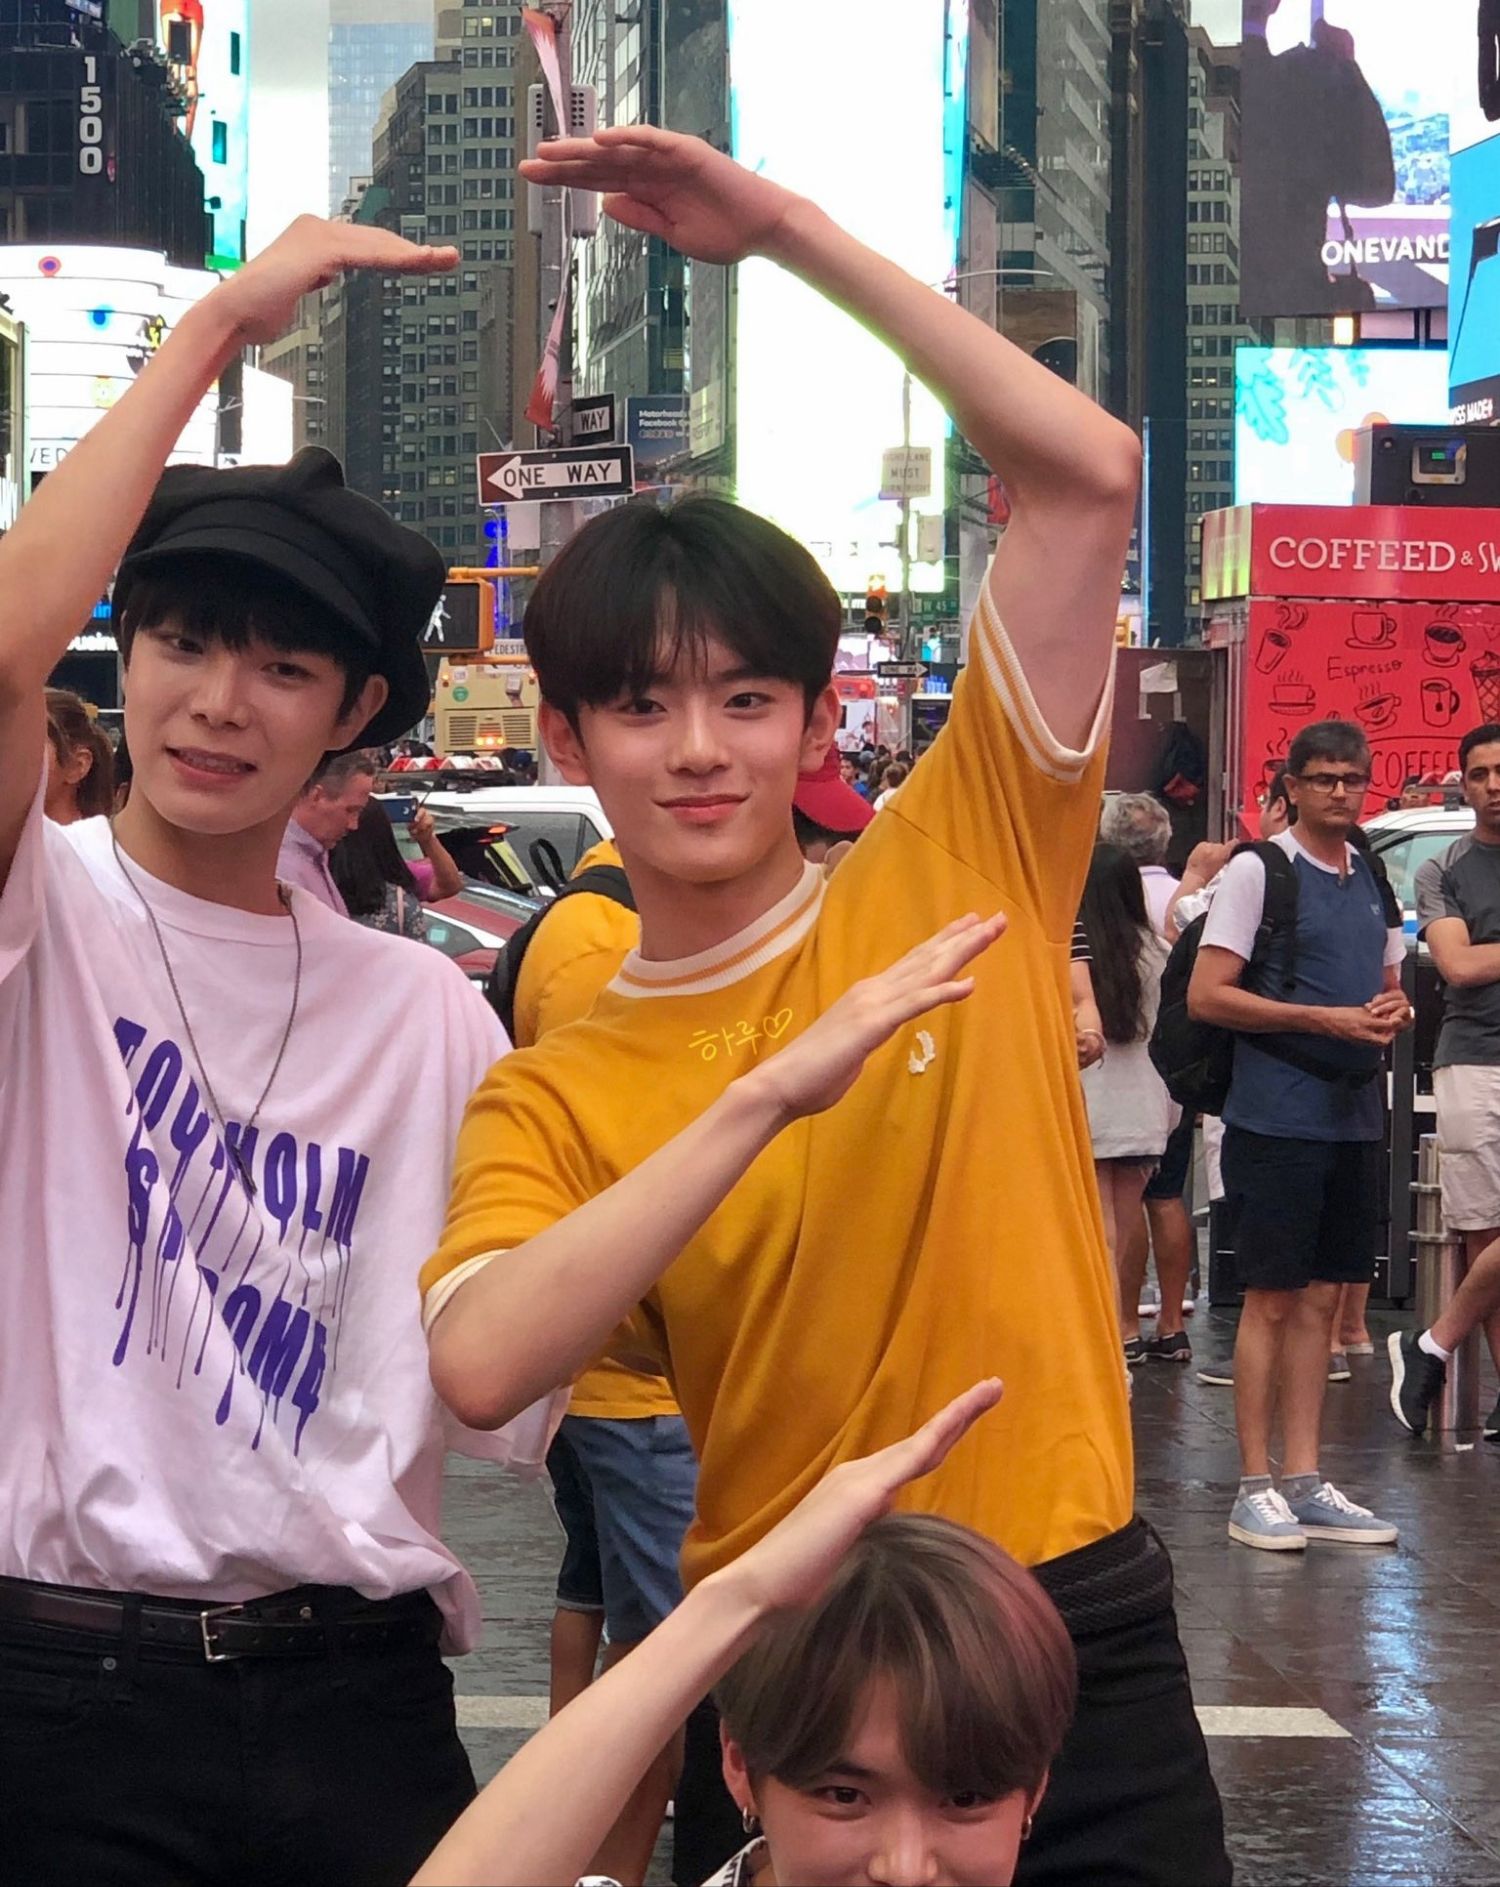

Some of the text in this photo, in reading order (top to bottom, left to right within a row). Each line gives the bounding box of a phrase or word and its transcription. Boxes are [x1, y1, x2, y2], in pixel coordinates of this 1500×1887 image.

[80, 56, 102, 174] 1500
[580, 410, 606, 431] WAY
[638, 419, 678, 427] Facebook
[503, 462, 612, 487] ONE WAY
[1269, 536, 1456, 572] COFFEED
[1460, 550, 1474, 566] &
[1327, 656, 1403, 684] Espresso
